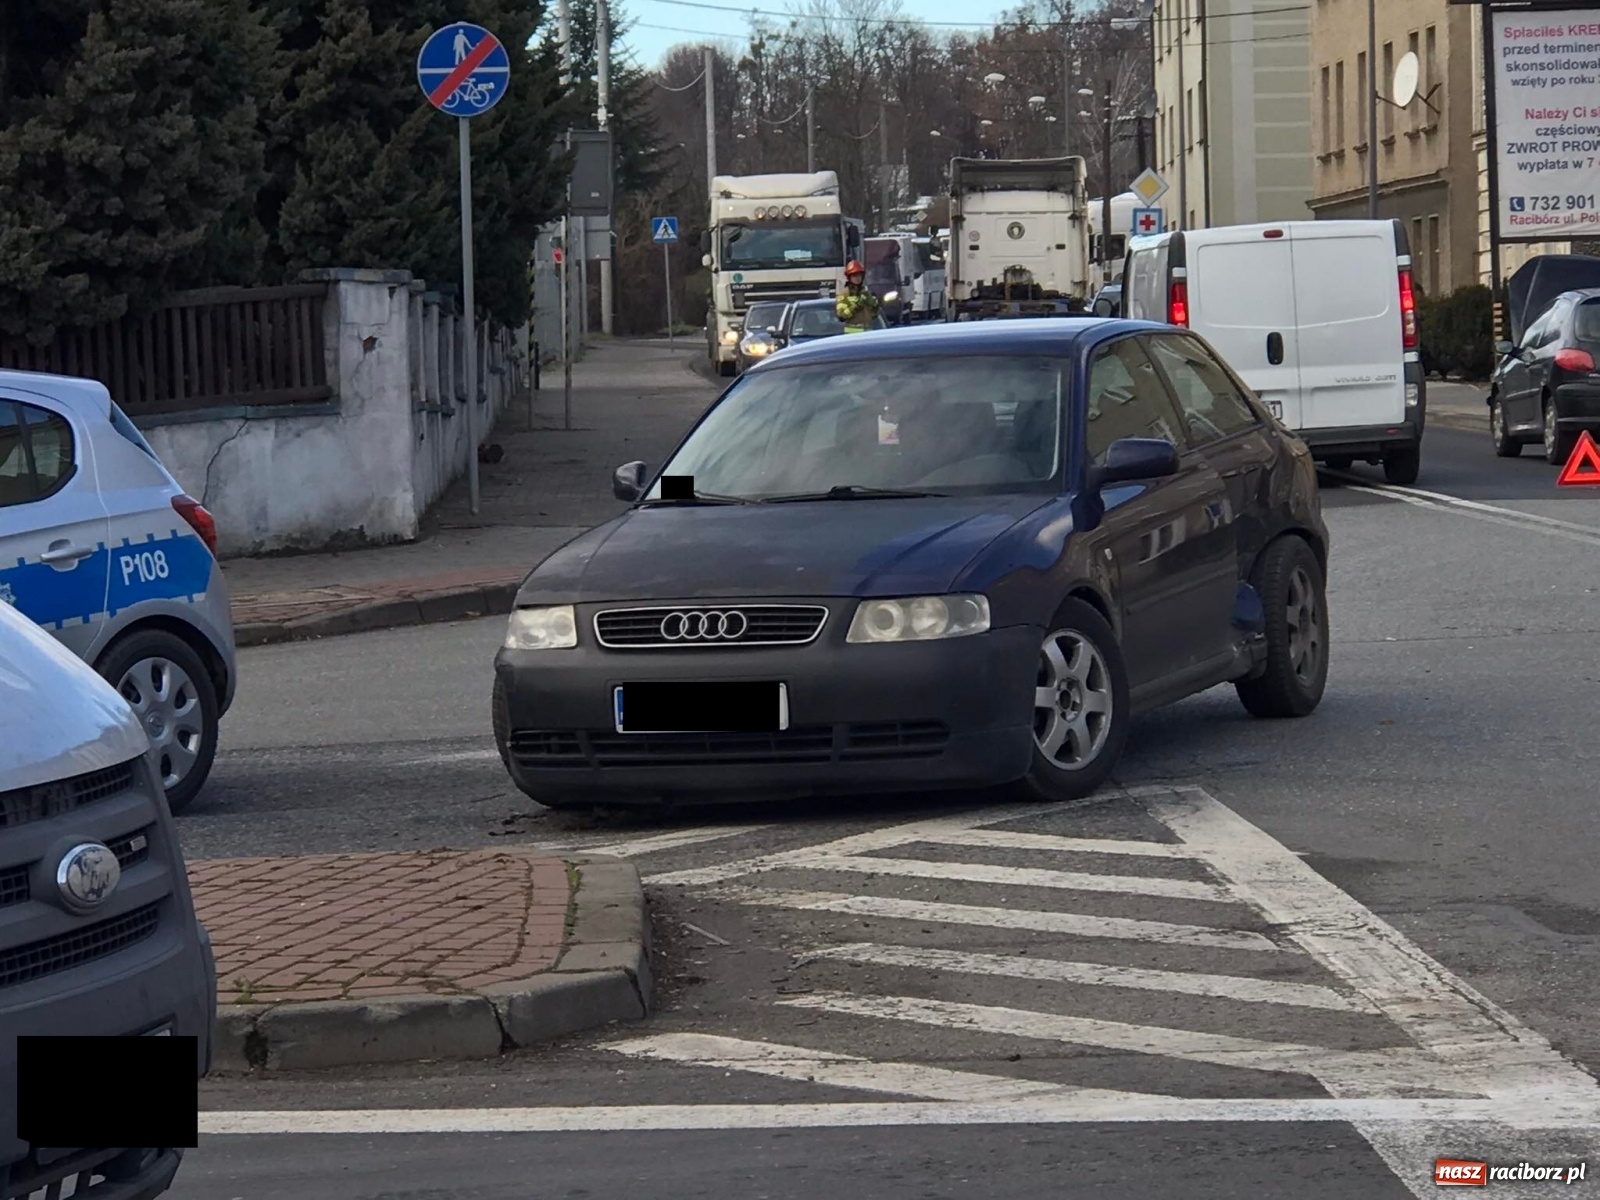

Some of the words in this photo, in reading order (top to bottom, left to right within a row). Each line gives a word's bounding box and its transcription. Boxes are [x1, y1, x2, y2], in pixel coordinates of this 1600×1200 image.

[1503, 26, 1564, 40] Spłaciłeś
[1567, 24, 1600, 36] KRE
[1502, 43, 1540, 58] przed
[1510, 75, 1548, 88] wzięty
[1550, 77, 1566, 87] po
[1568, 74, 1595, 84] roku
[1525, 108, 1569, 121] Należy
[1572, 106, 1587, 118] Ci
[1506, 142, 1558, 154] ZWROT
[1517, 158, 1568, 173] wypłata
[1572, 160, 1583, 169] w
[1587, 157, 1595, 168] 7
[1530, 195, 1561, 211] 732
[1565, 194, 1595, 210] 901
[1510, 214, 1560, 225] Racibórz
[119, 549, 169, 586] P108
